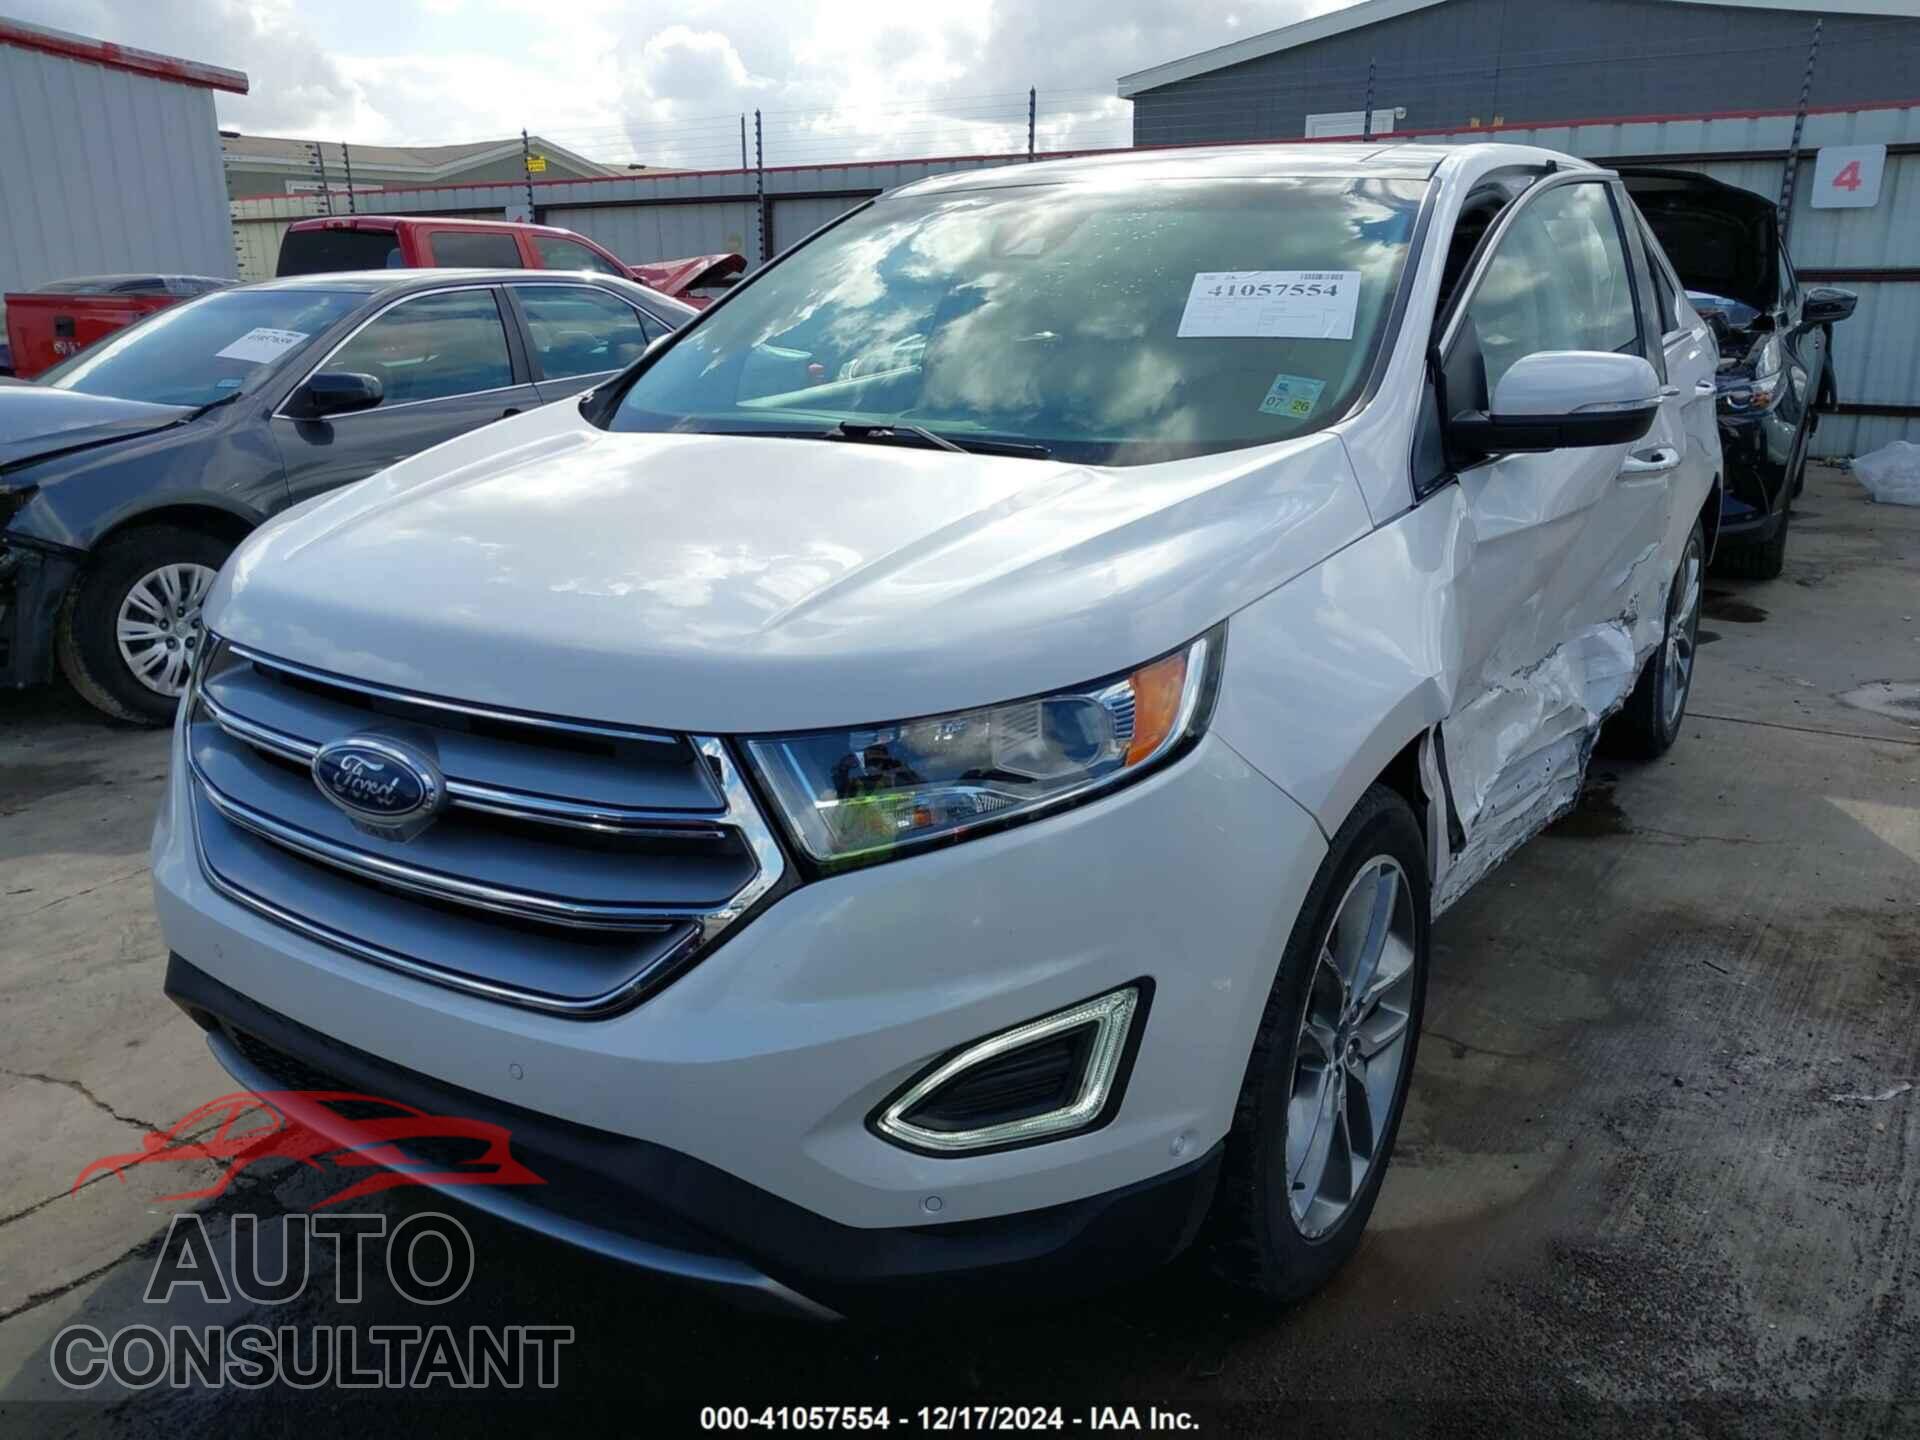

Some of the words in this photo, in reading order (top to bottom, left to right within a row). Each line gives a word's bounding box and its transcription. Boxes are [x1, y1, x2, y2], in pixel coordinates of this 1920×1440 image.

[1831, 160, 1862, 192] 4
[1208, 283, 1338, 297] 41057554
[1266, 395, 1285, 409] 07
[1292, 400, 1311, 412] 26
[333, 754, 400, 805] Ford
